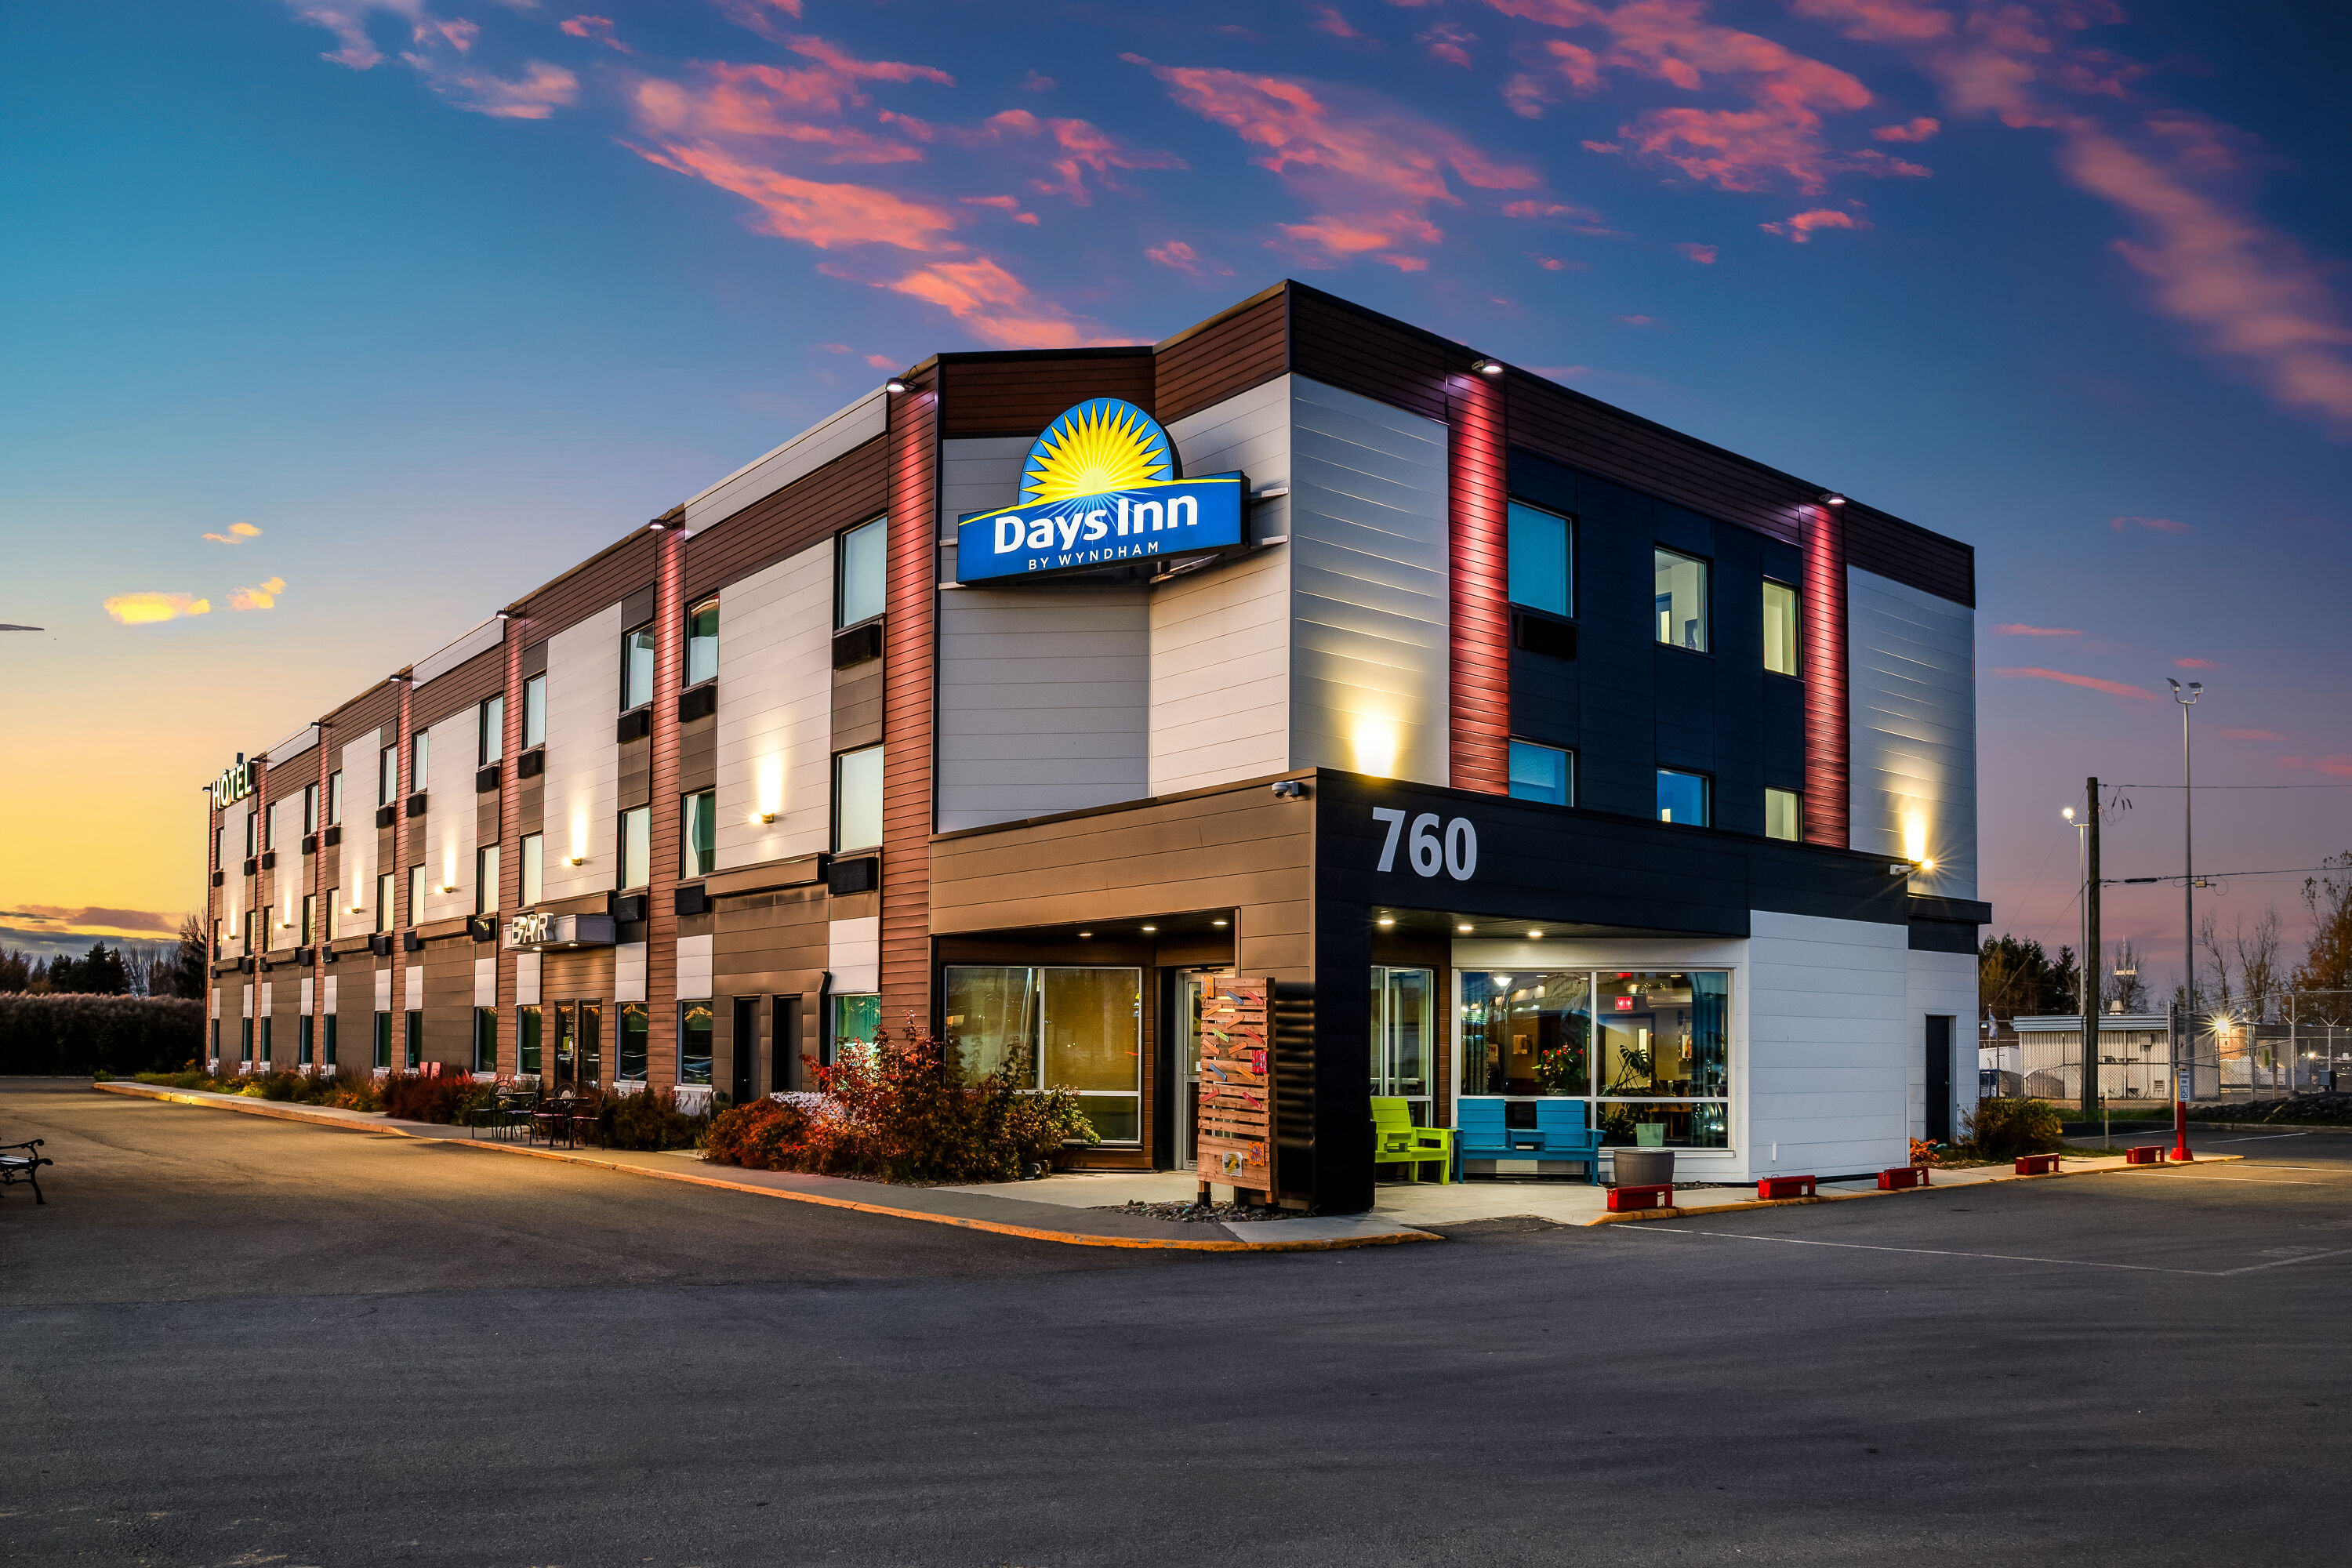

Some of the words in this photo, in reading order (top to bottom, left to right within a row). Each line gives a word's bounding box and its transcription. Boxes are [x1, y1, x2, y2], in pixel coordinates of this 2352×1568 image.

[993, 508, 1109, 555] Days
[1117, 494, 1199, 537] Inn
[1029, 557, 1049, 571] BY
[1058, 541, 1159, 566] WYNDHAM
[1372, 806, 1477, 880] 760
[511, 913, 550, 945] BAR
